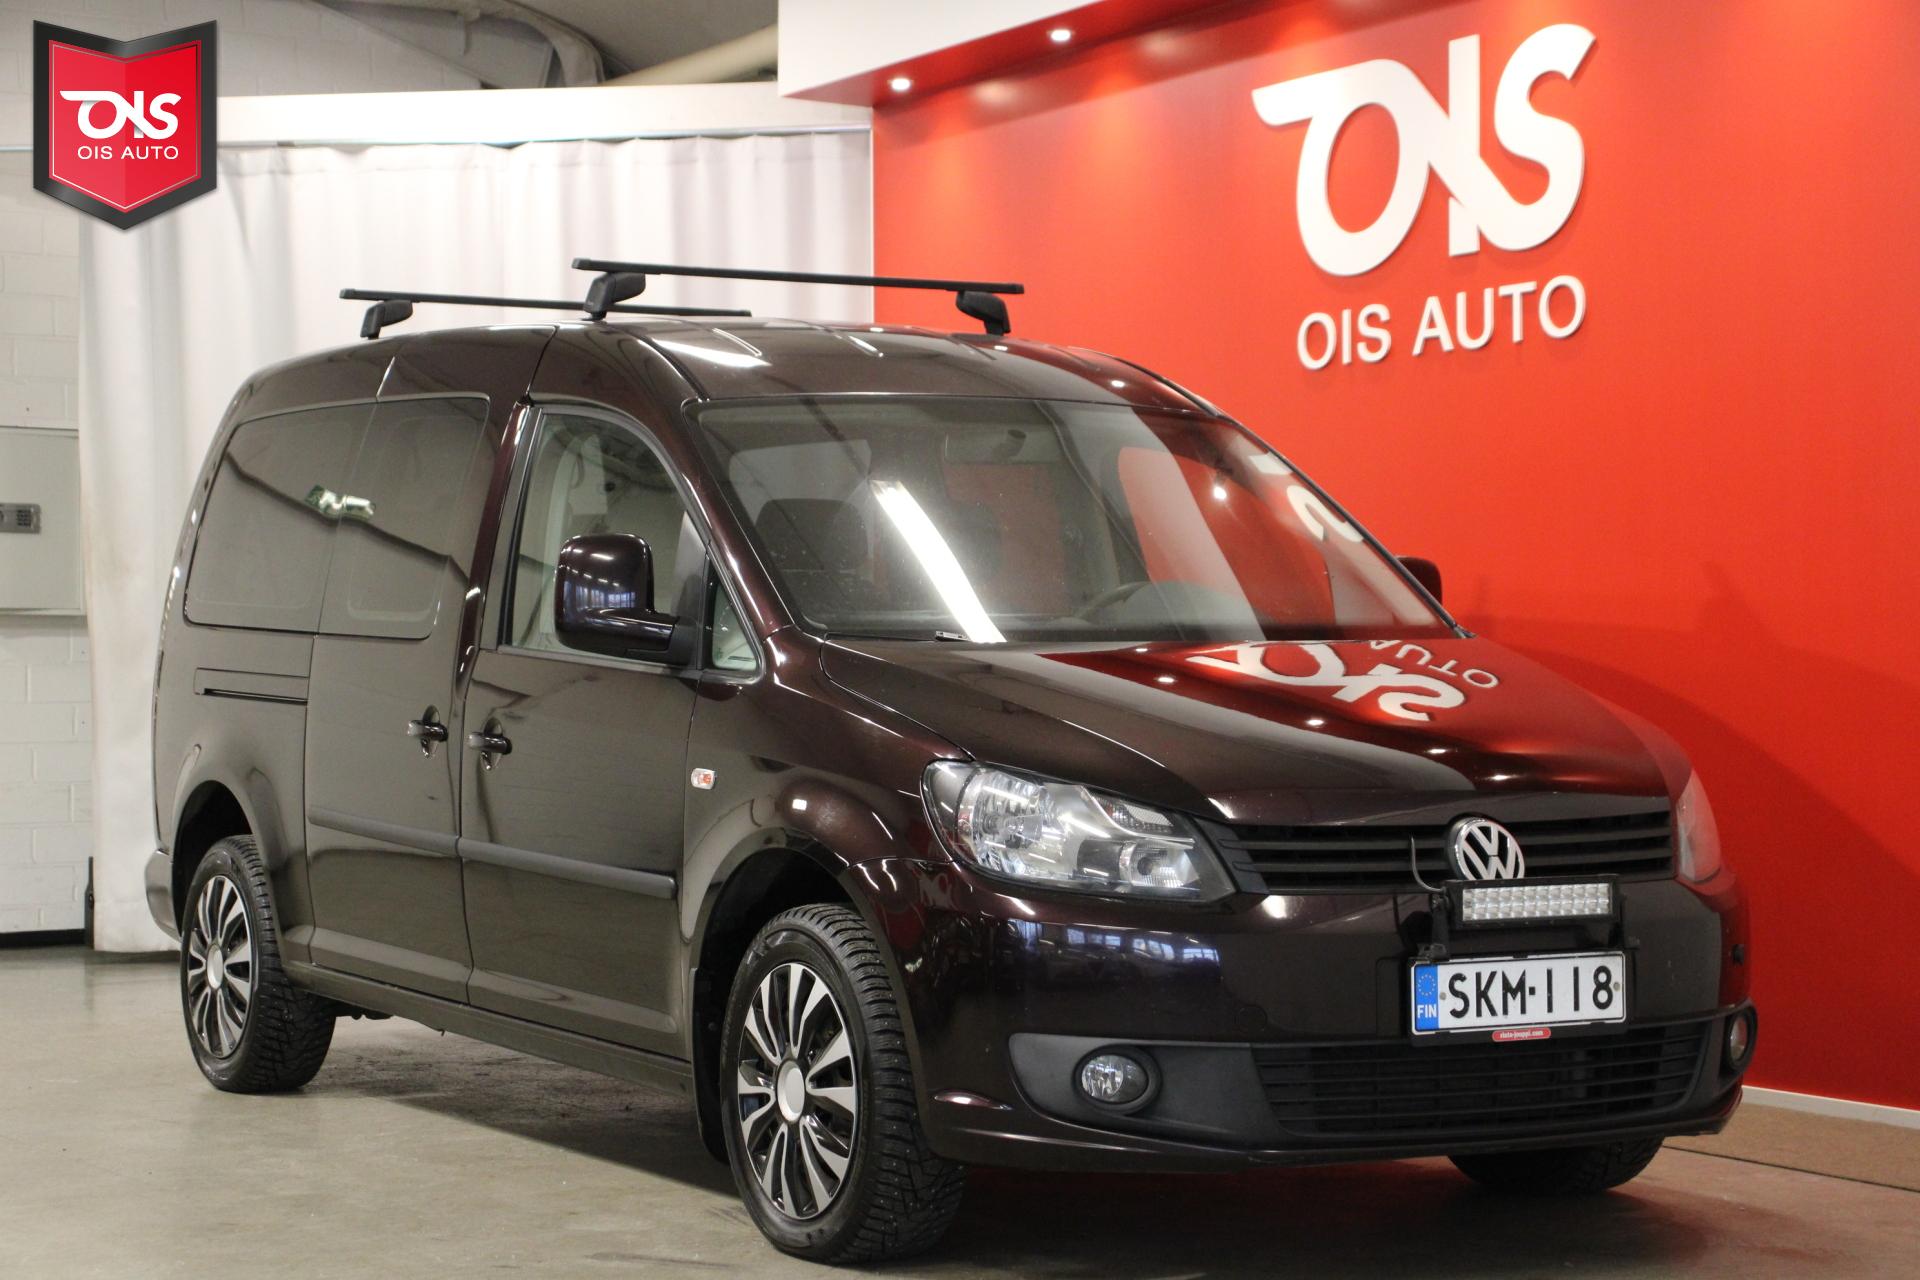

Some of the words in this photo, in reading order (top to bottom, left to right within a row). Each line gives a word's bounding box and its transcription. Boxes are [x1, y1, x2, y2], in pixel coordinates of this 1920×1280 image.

[1251, 24, 1596, 277] OIS
[1297, 303, 1392, 371] OIS
[1412, 275, 1587, 356] AUTO
[1416, 1003, 1438, 1019] FIN
